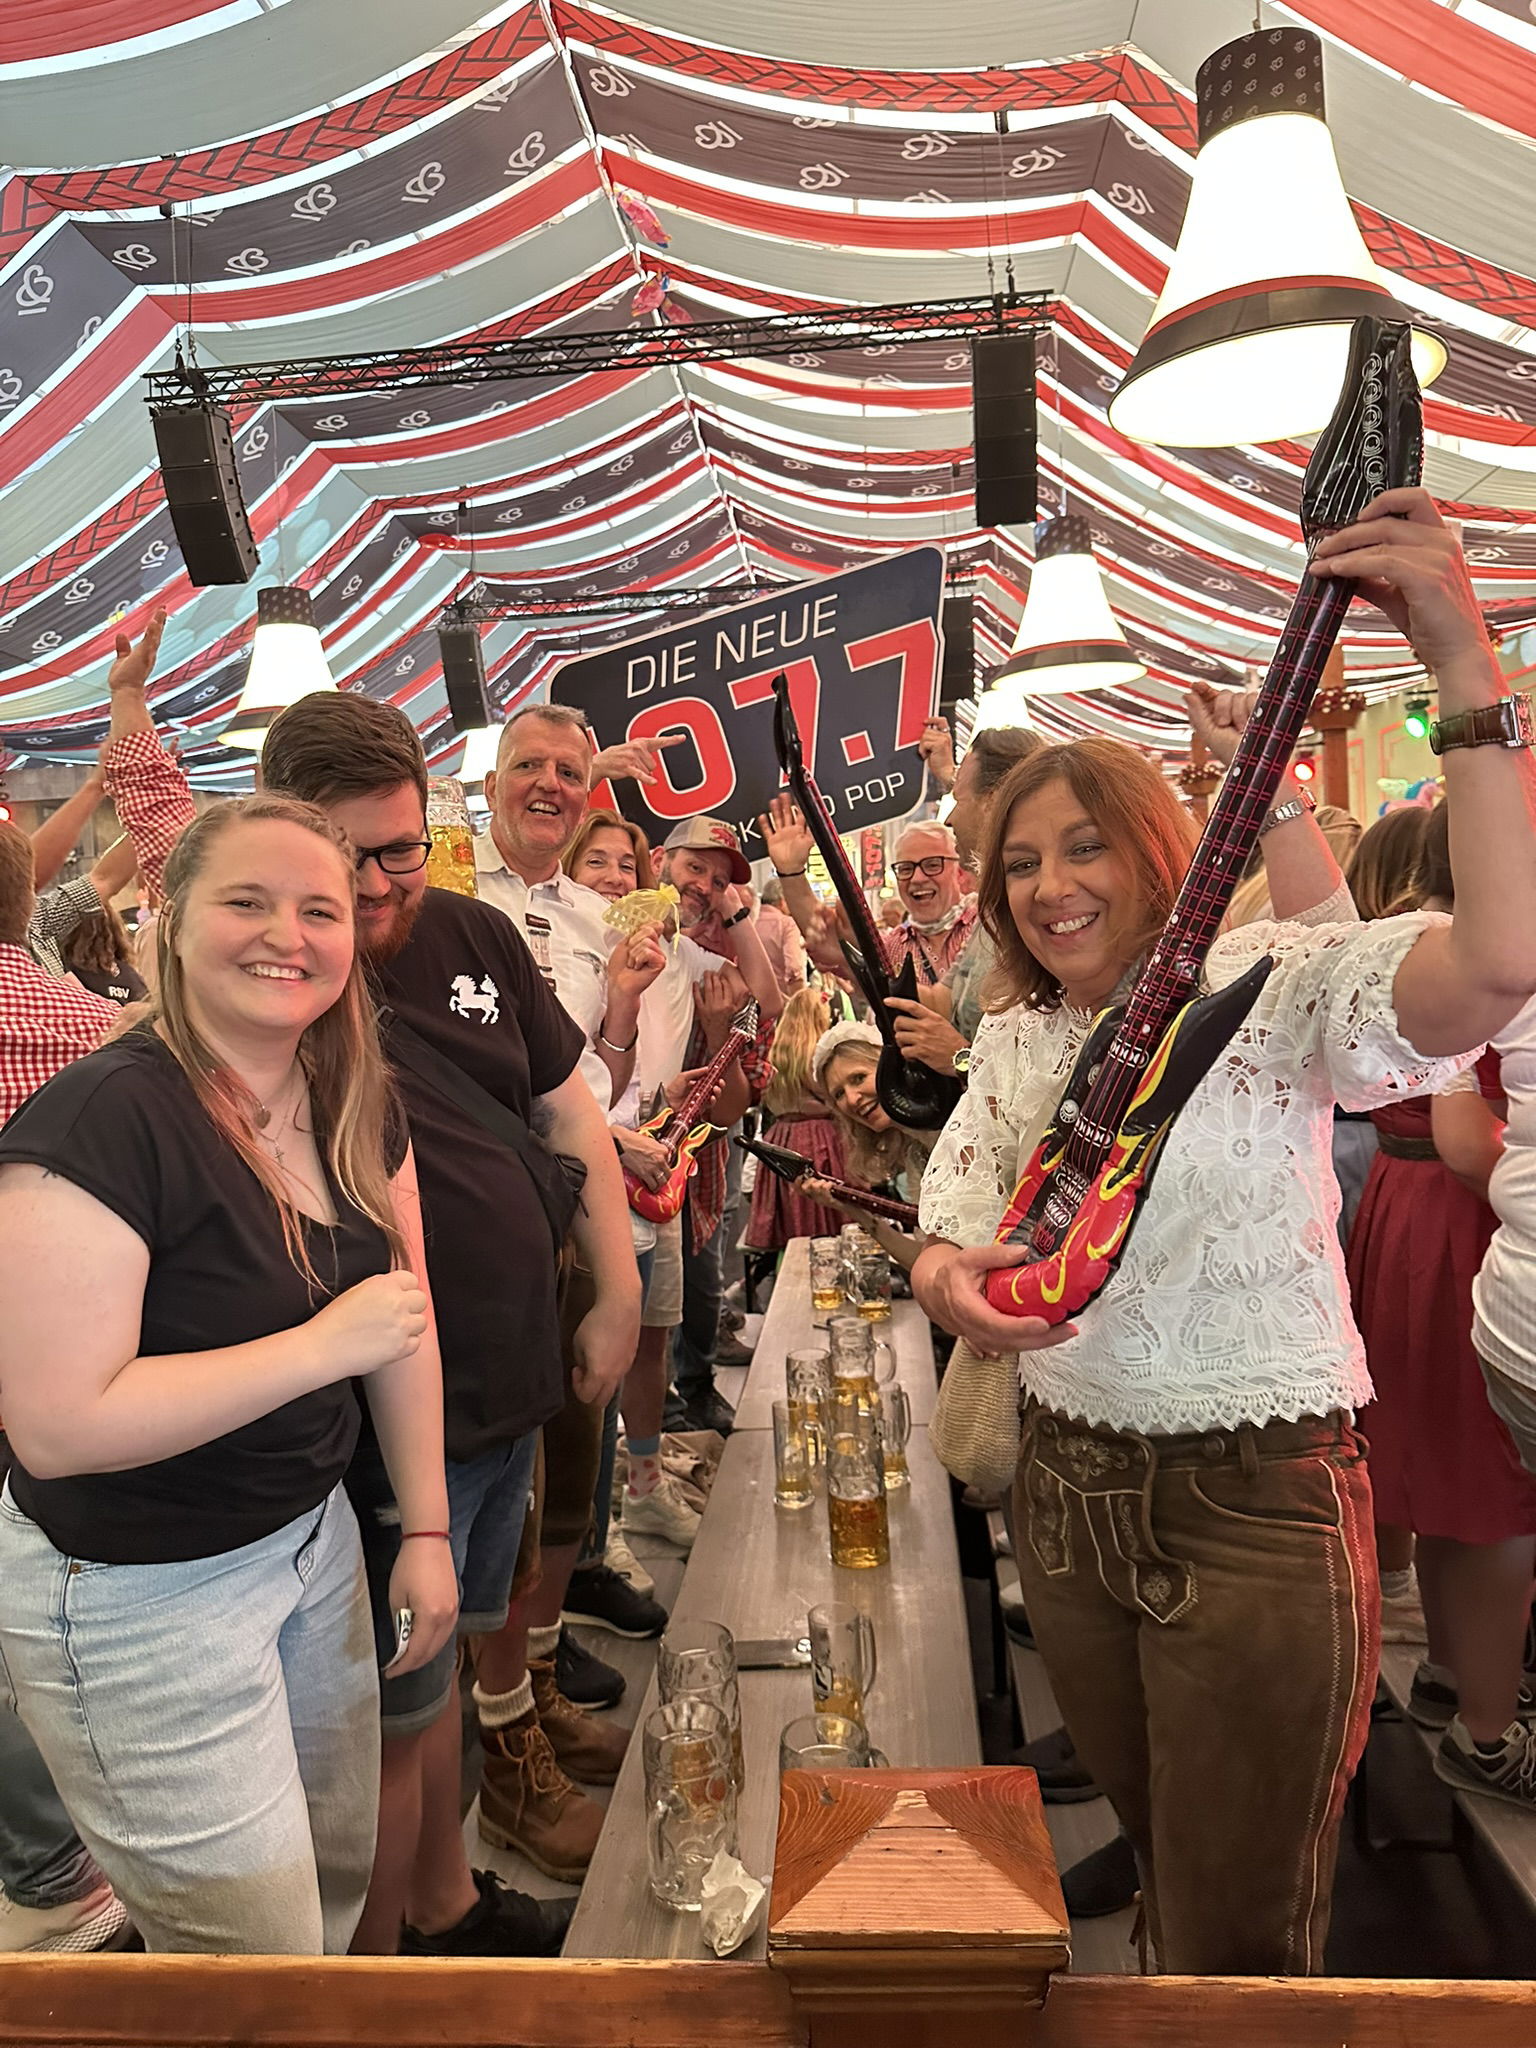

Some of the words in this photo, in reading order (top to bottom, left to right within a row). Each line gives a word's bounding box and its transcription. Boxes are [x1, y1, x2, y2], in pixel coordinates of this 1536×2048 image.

[627, 641, 696, 699] DIE
[715, 594, 838, 670] NEUE
[845, 772, 905, 810] POP
